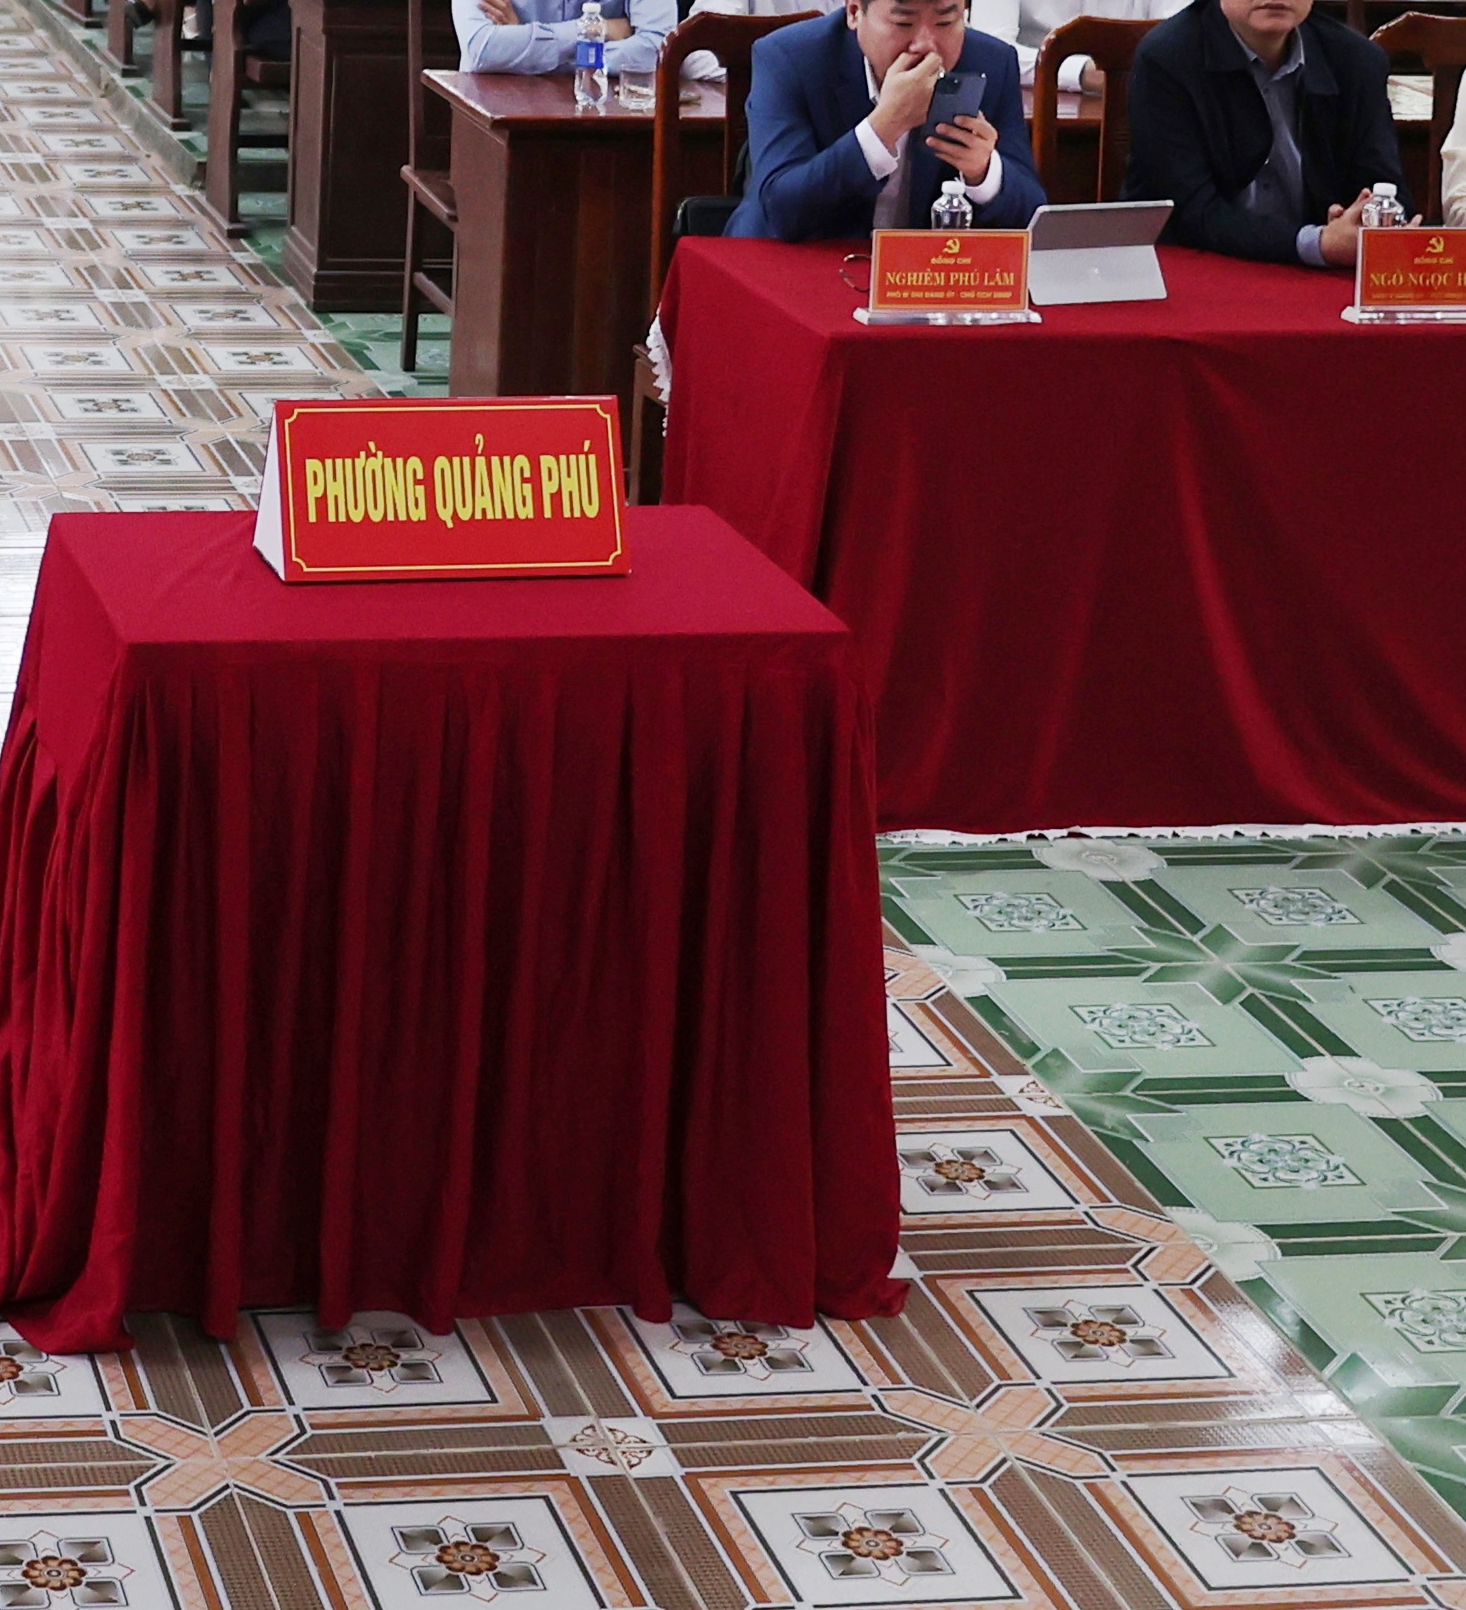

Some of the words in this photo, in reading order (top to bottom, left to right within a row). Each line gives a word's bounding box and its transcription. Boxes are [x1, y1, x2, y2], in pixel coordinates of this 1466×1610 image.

[885, 268, 945, 286] NGHIÊM
[949, 269, 980, 286] PHÚ
[1408, 272, 1453, 290] NGỌC
[305, 440, 427, 523] PHƯỜNG
[433, 433, 534, 529] QUẢNG
[539, 439, 600, 519] PHÚ
